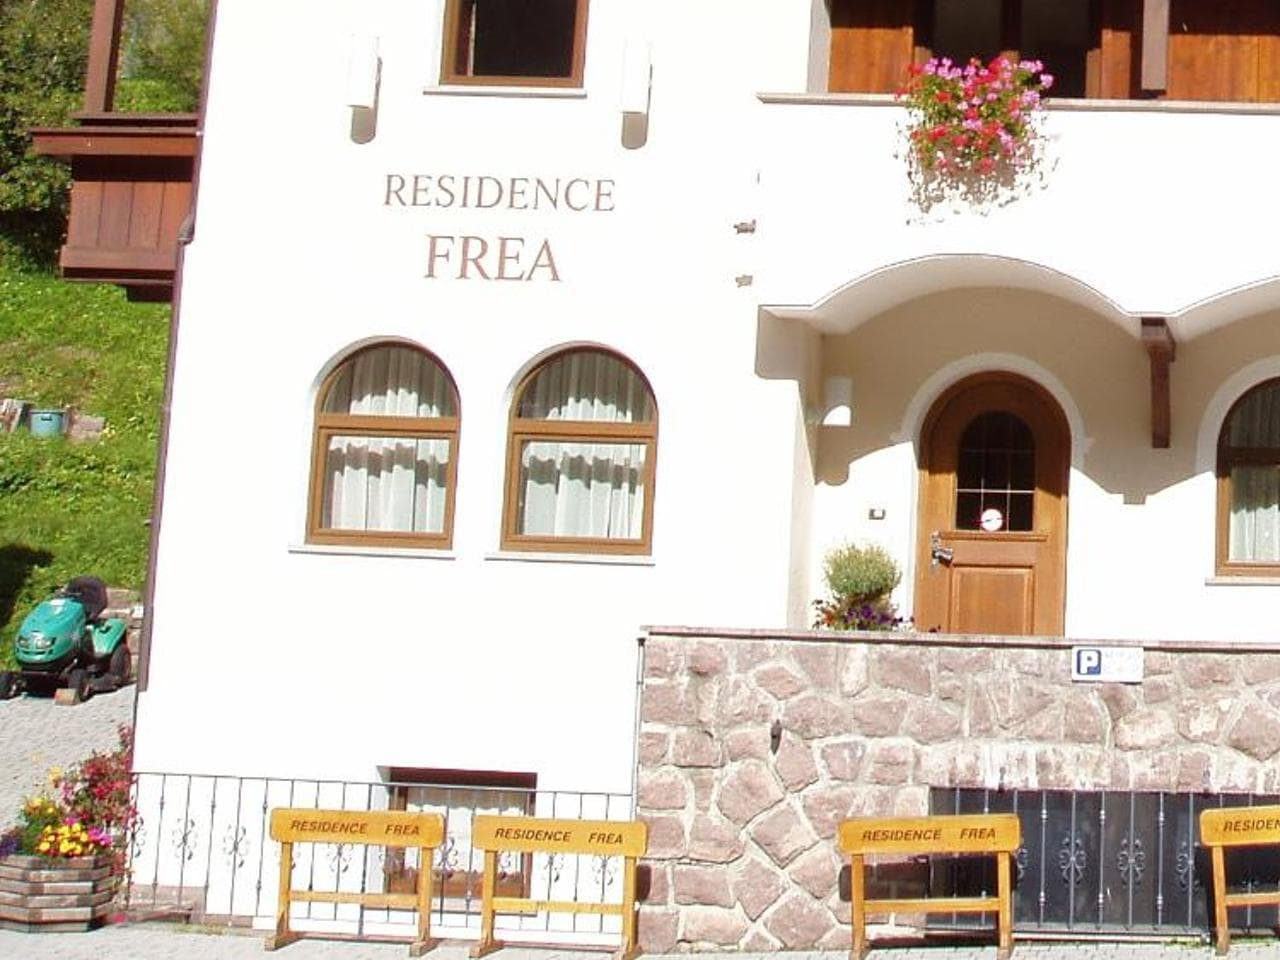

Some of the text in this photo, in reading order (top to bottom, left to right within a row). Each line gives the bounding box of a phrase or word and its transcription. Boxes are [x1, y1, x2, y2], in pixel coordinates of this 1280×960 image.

[384, 173, 616, 212] RESIDENCE
[424, 233, 562, 282] FREA
[1080, 650, 1100, 675] P
[290, 819, 420, 836] RESIDENCE FREA
[494, 827, 624, 845] RESIDENCE FREA
[862, 827, 997, 842] RESIDENCE FREA
